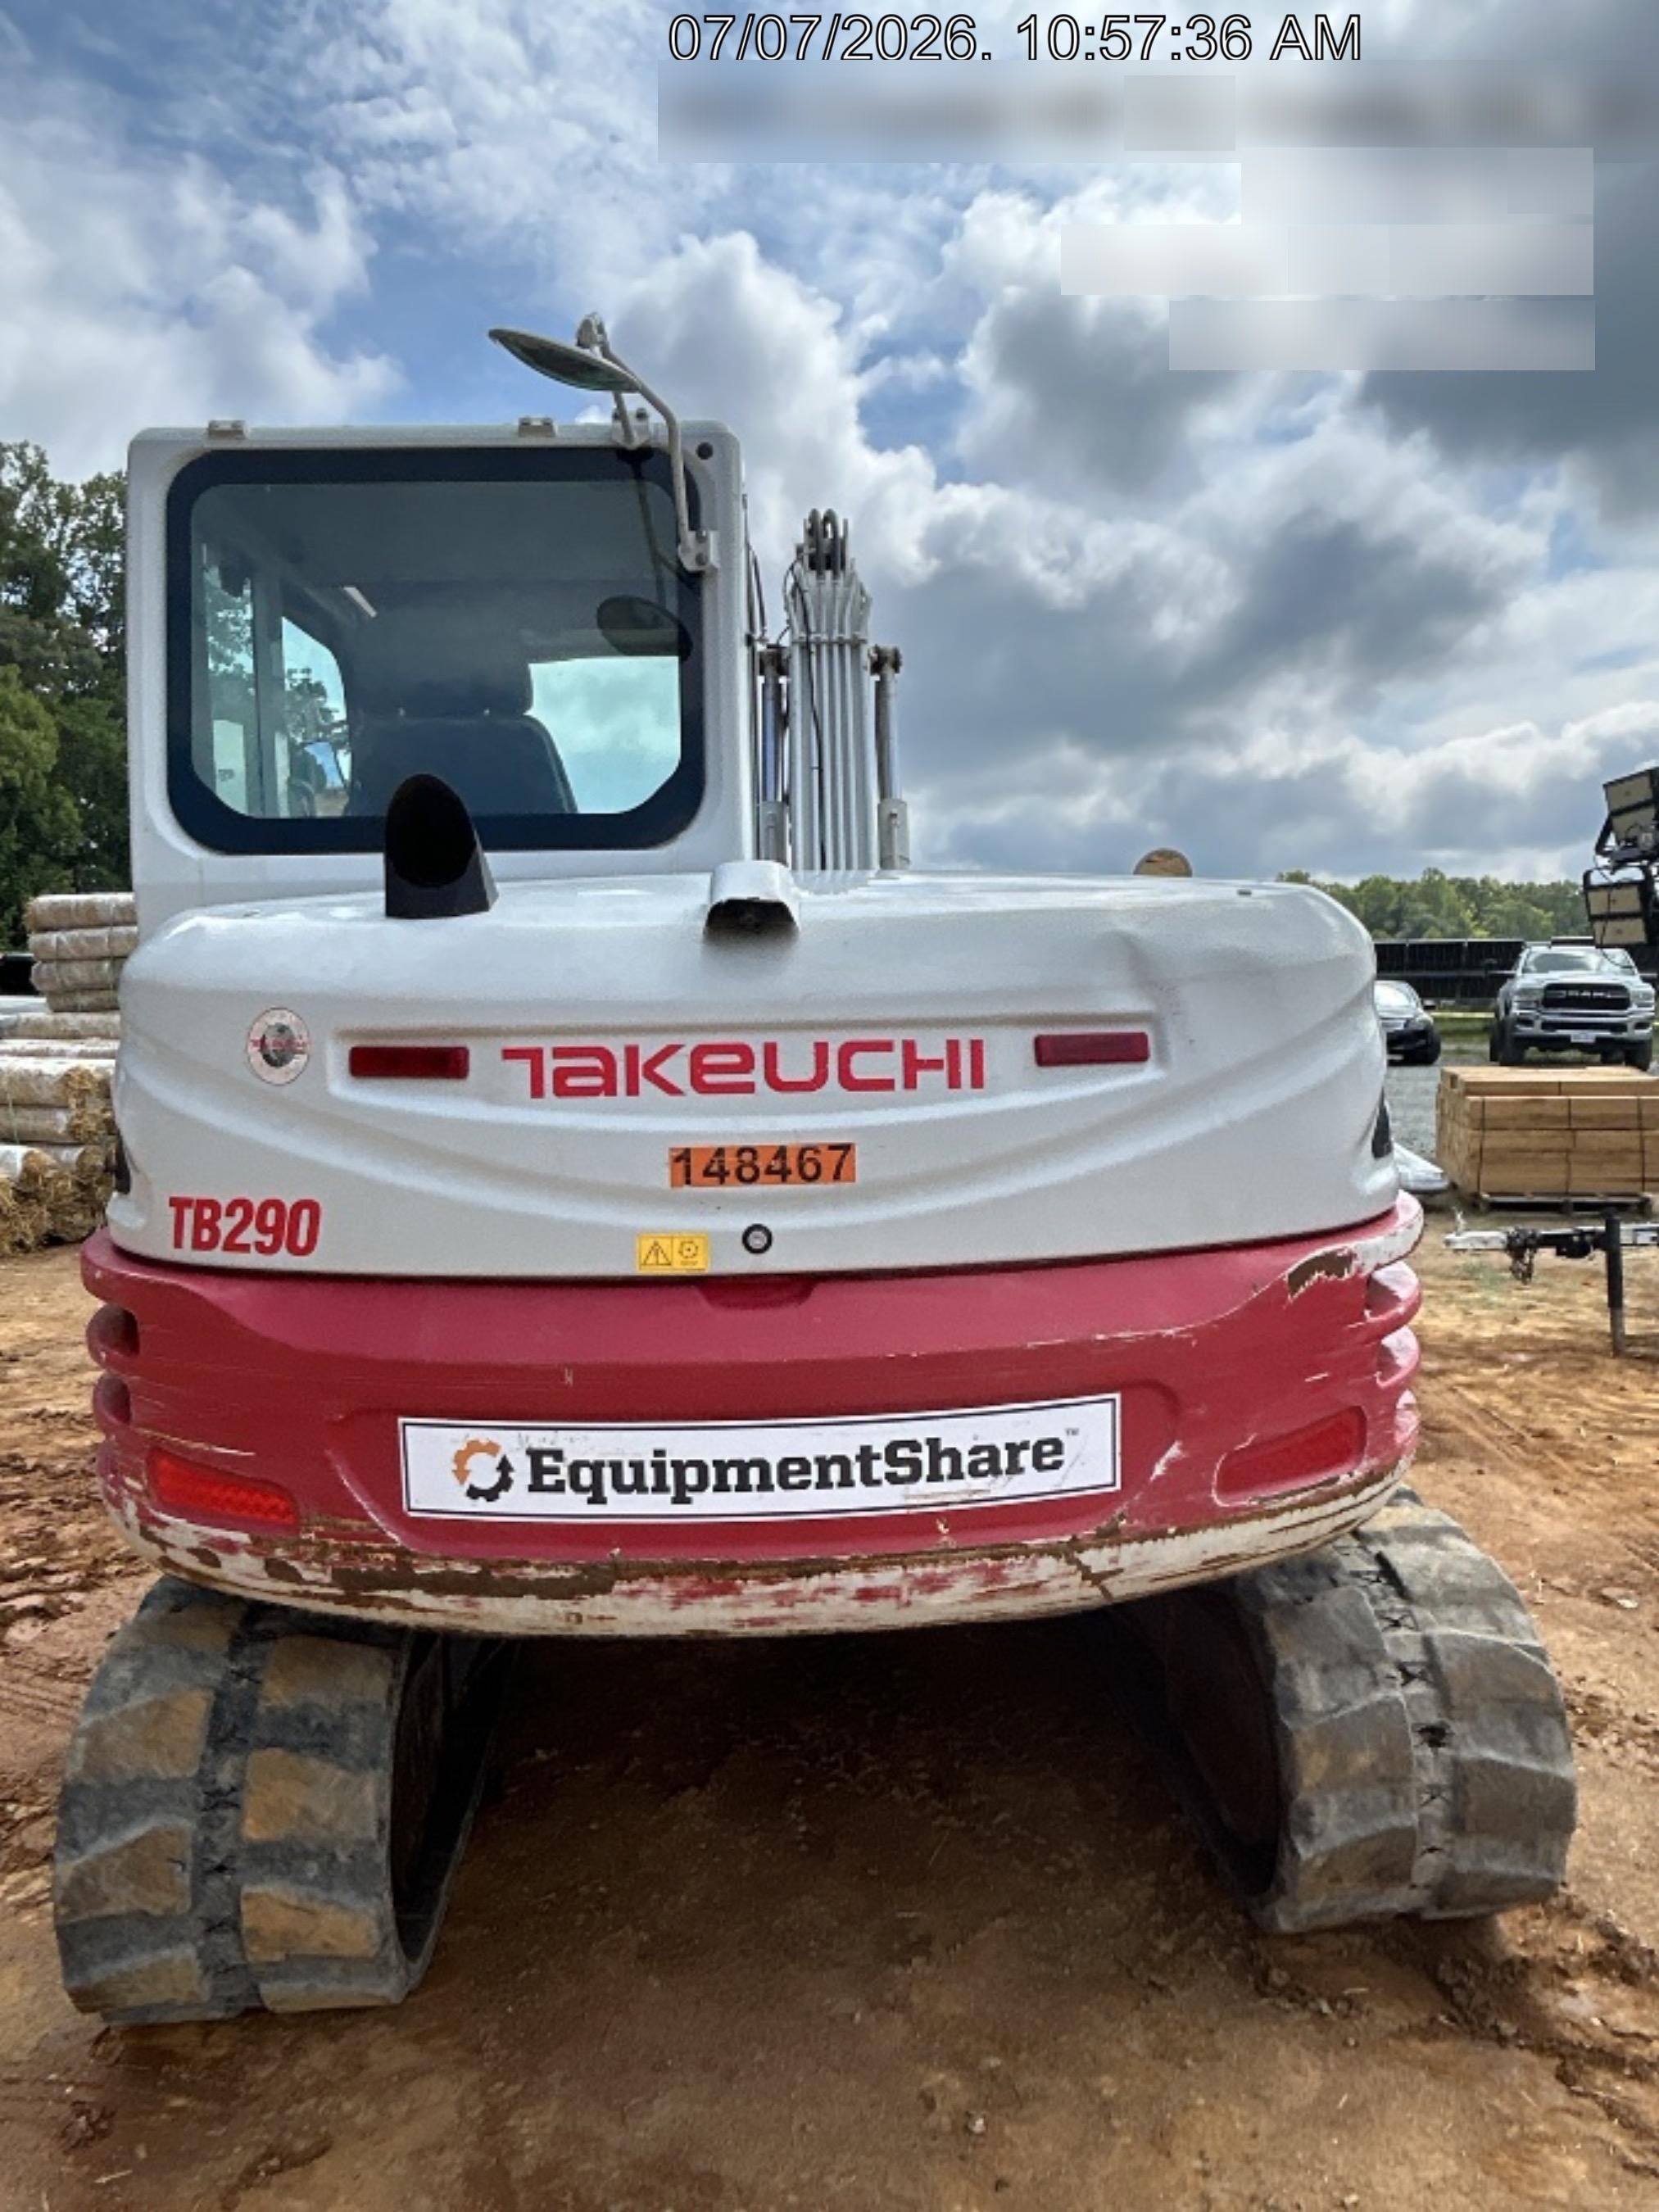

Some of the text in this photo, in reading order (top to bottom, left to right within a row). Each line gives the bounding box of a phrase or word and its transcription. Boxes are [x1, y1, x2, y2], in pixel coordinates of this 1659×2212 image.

[673, 1145, 852, 1185] 148467
[169, 1196, 320, 1257] TB290
[526, 1436, 1064, 1505] EquipmentShare
